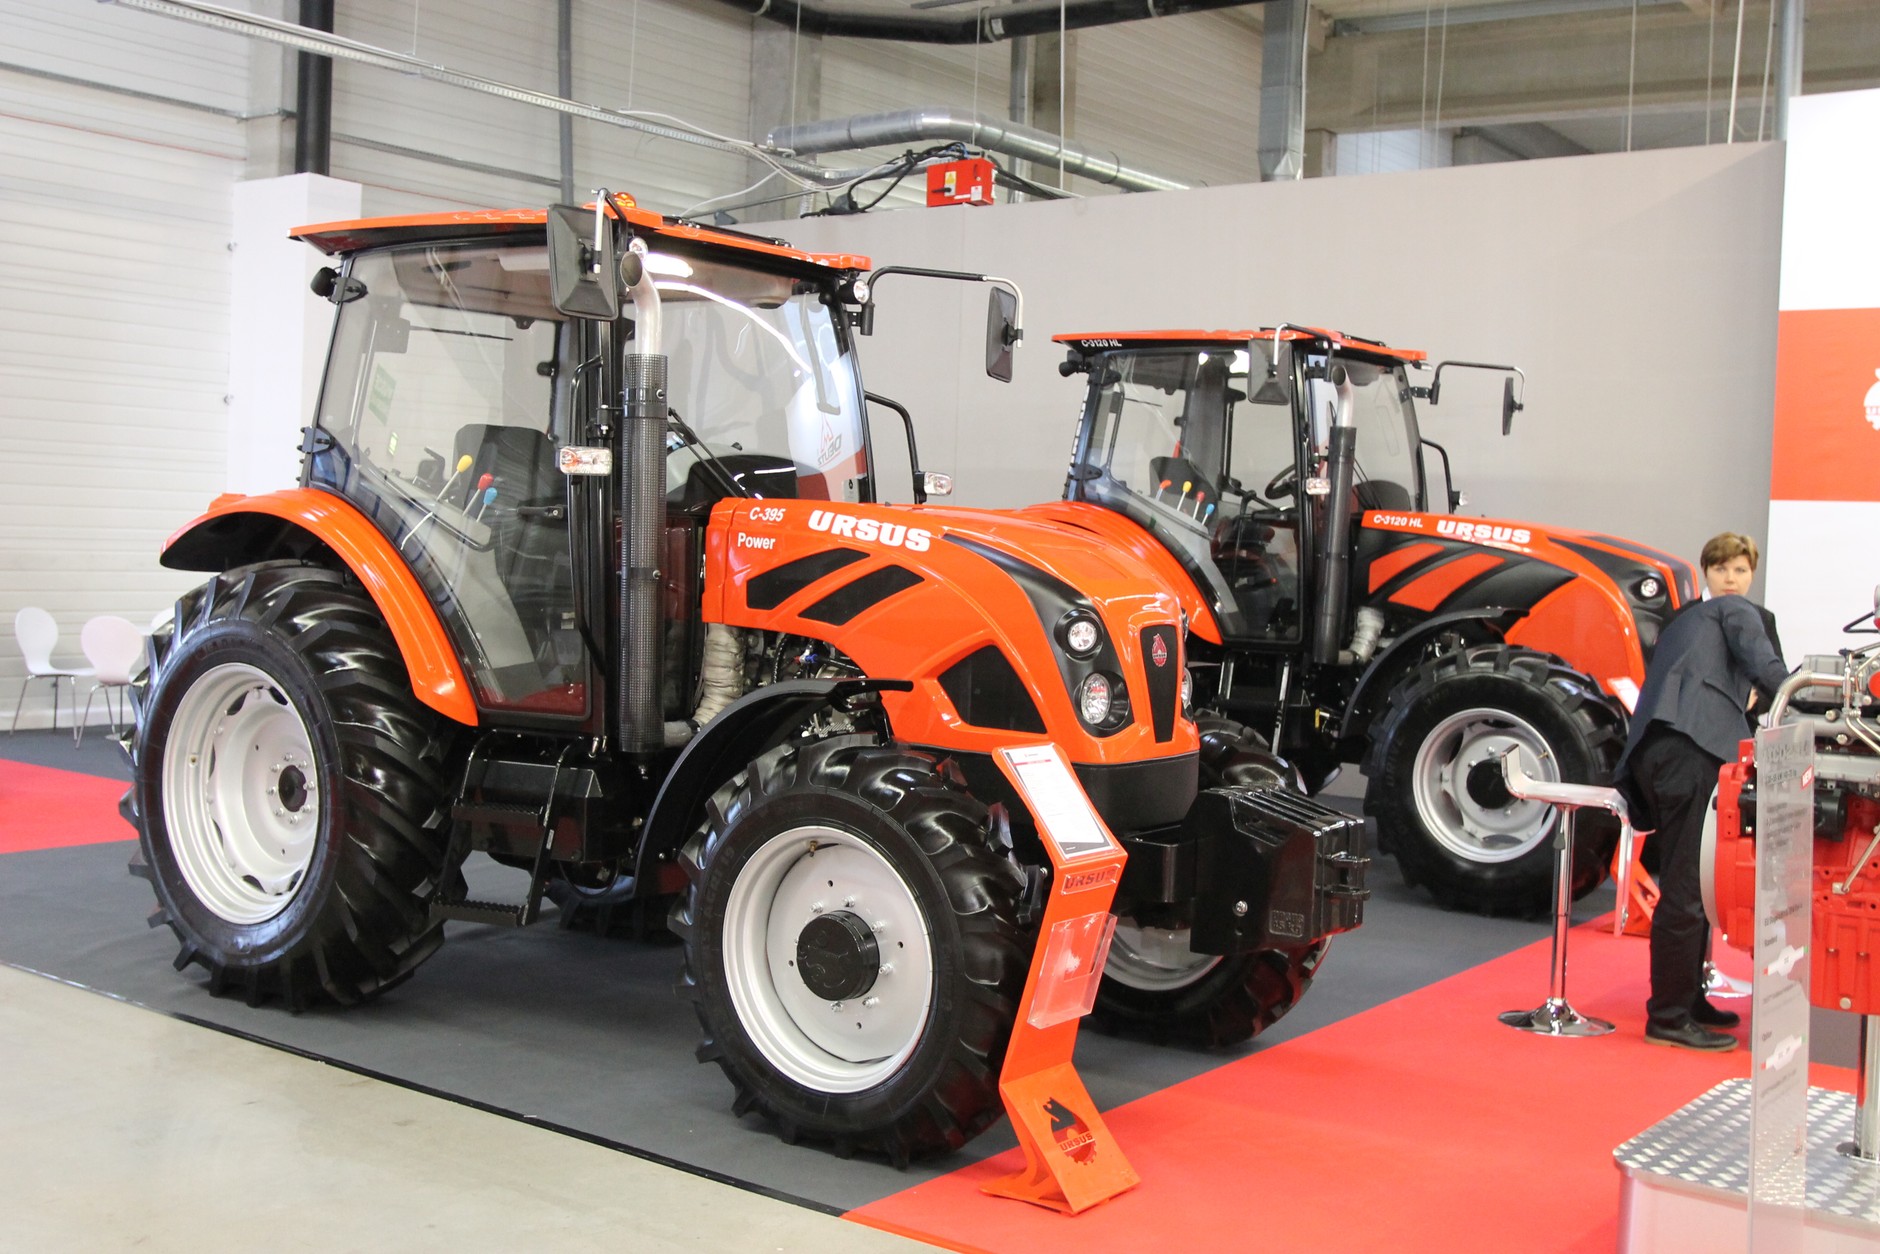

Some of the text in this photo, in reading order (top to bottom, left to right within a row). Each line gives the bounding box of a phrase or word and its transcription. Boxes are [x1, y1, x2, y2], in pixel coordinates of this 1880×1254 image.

[1081, 339, 1123, 347] C-3120 HL
[749, 506, 786, 523] C-395
[1373, 514, 1424, 528] C-3120 HL
[807, 509, 932, 552] URSUS
[1436, 520, 1532, 544] URSUS
[737, 532, 776, 550] Power
[1064, 869, 1115, 889] URSUS
[1059, 1133, 1094, 1151] URSUS
